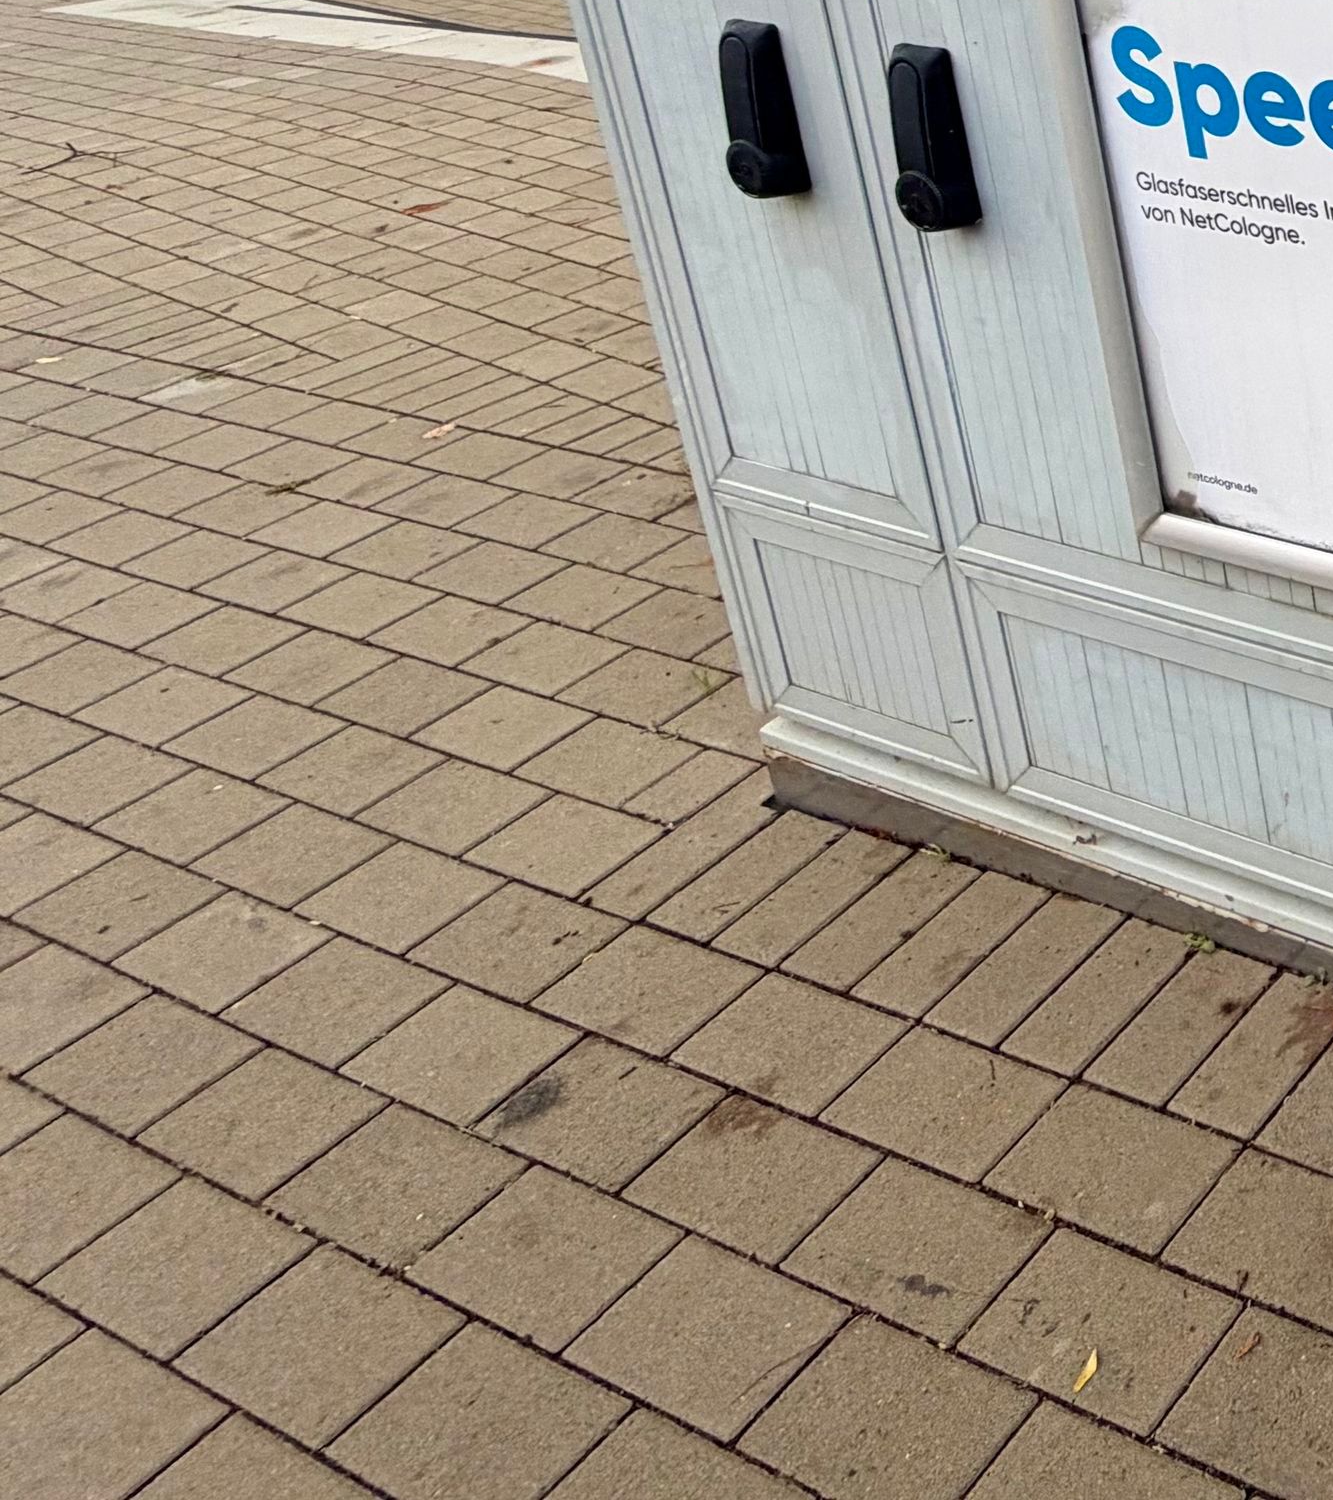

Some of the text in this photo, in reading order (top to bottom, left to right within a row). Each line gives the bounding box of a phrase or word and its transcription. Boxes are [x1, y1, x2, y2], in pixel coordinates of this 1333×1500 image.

[1136, 171, 1319, 218] Glasfaserschnelles
[1140, 205, 1306, 245] von NetCologne.
[1187, 471, 1258, 495] netcologne.de
